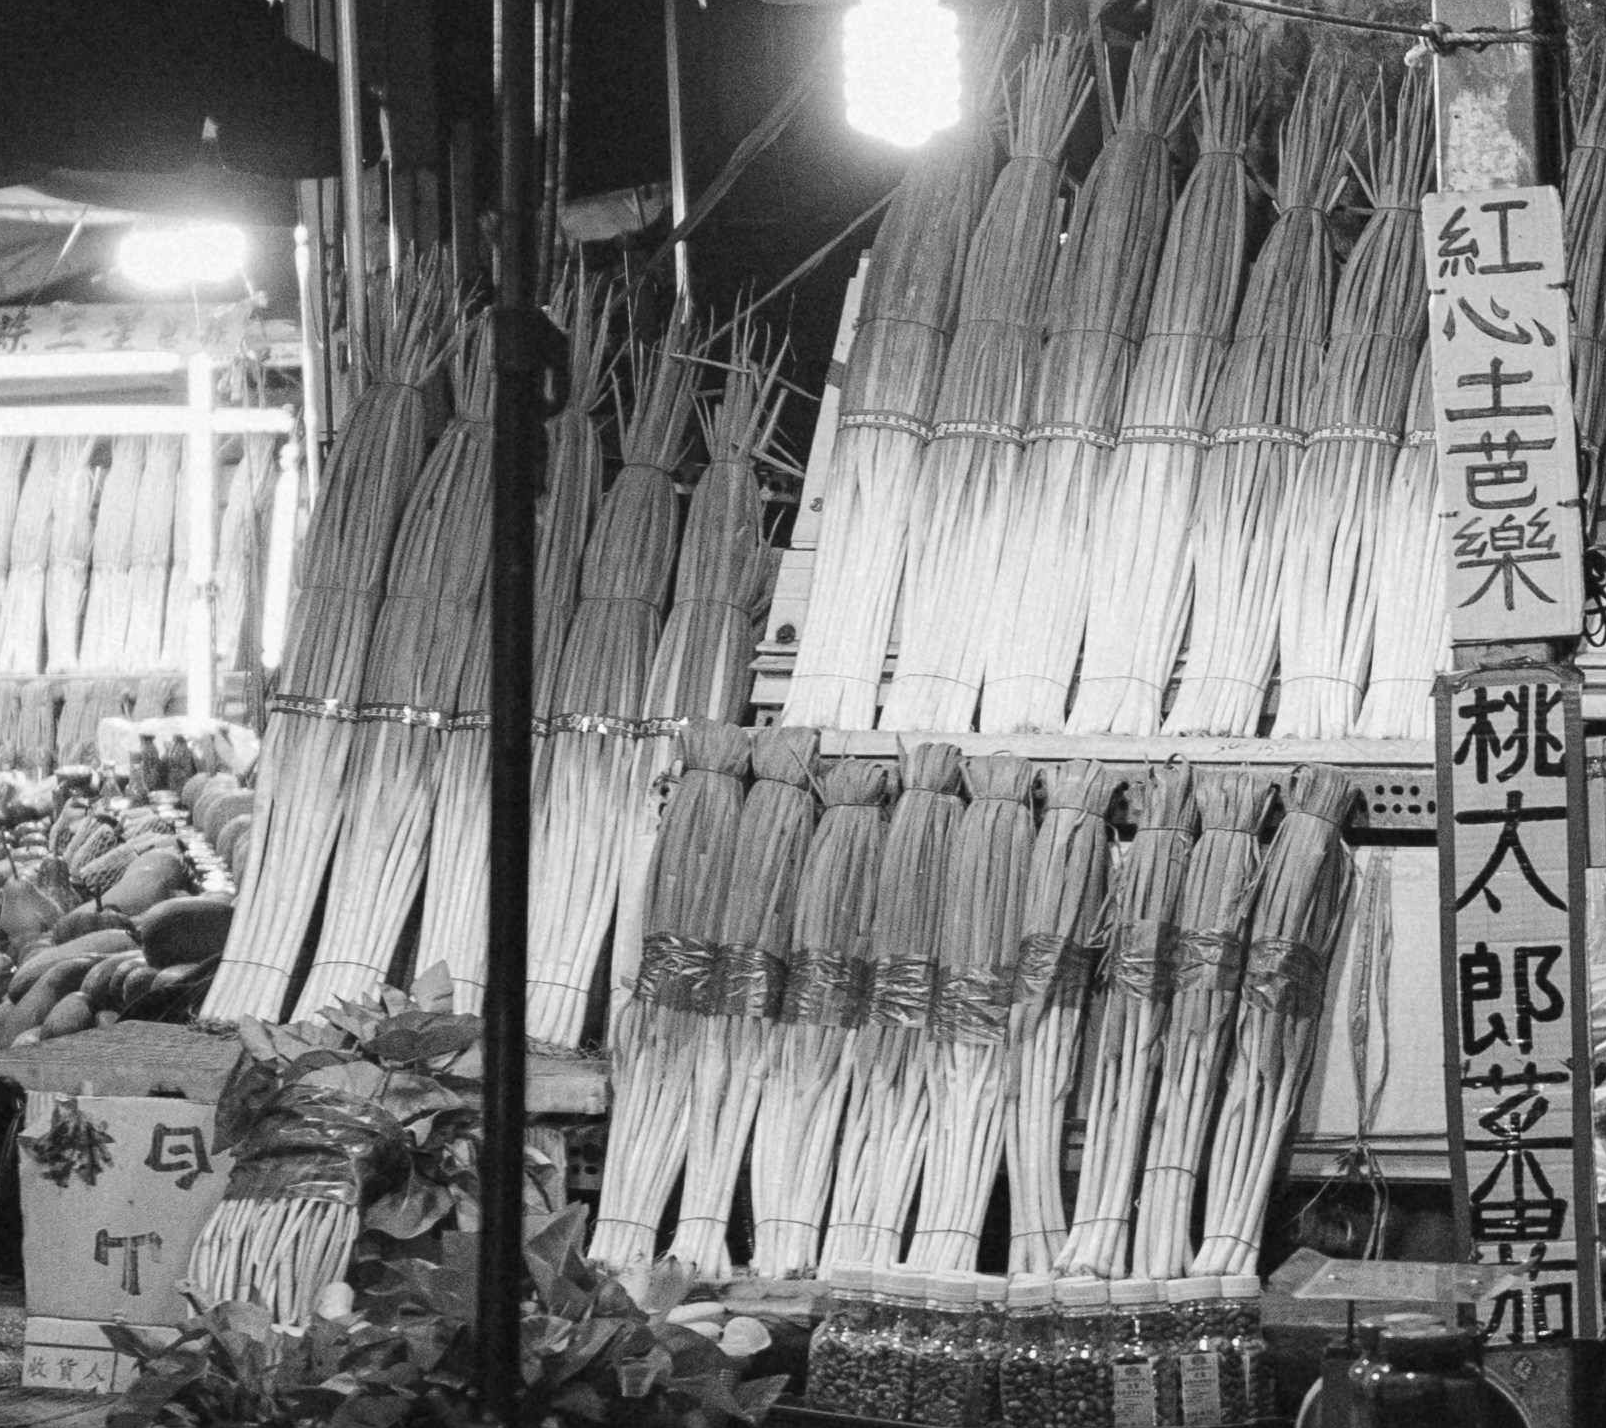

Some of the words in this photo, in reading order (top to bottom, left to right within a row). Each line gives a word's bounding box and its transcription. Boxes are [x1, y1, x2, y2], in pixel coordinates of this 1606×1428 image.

[1438, 200, 1560, 611] 紅心土芭樂
[1452, 683, 1576, 1345] 桃太郎蕃茄
[27, 1356, 105, 1382] 收貨人
